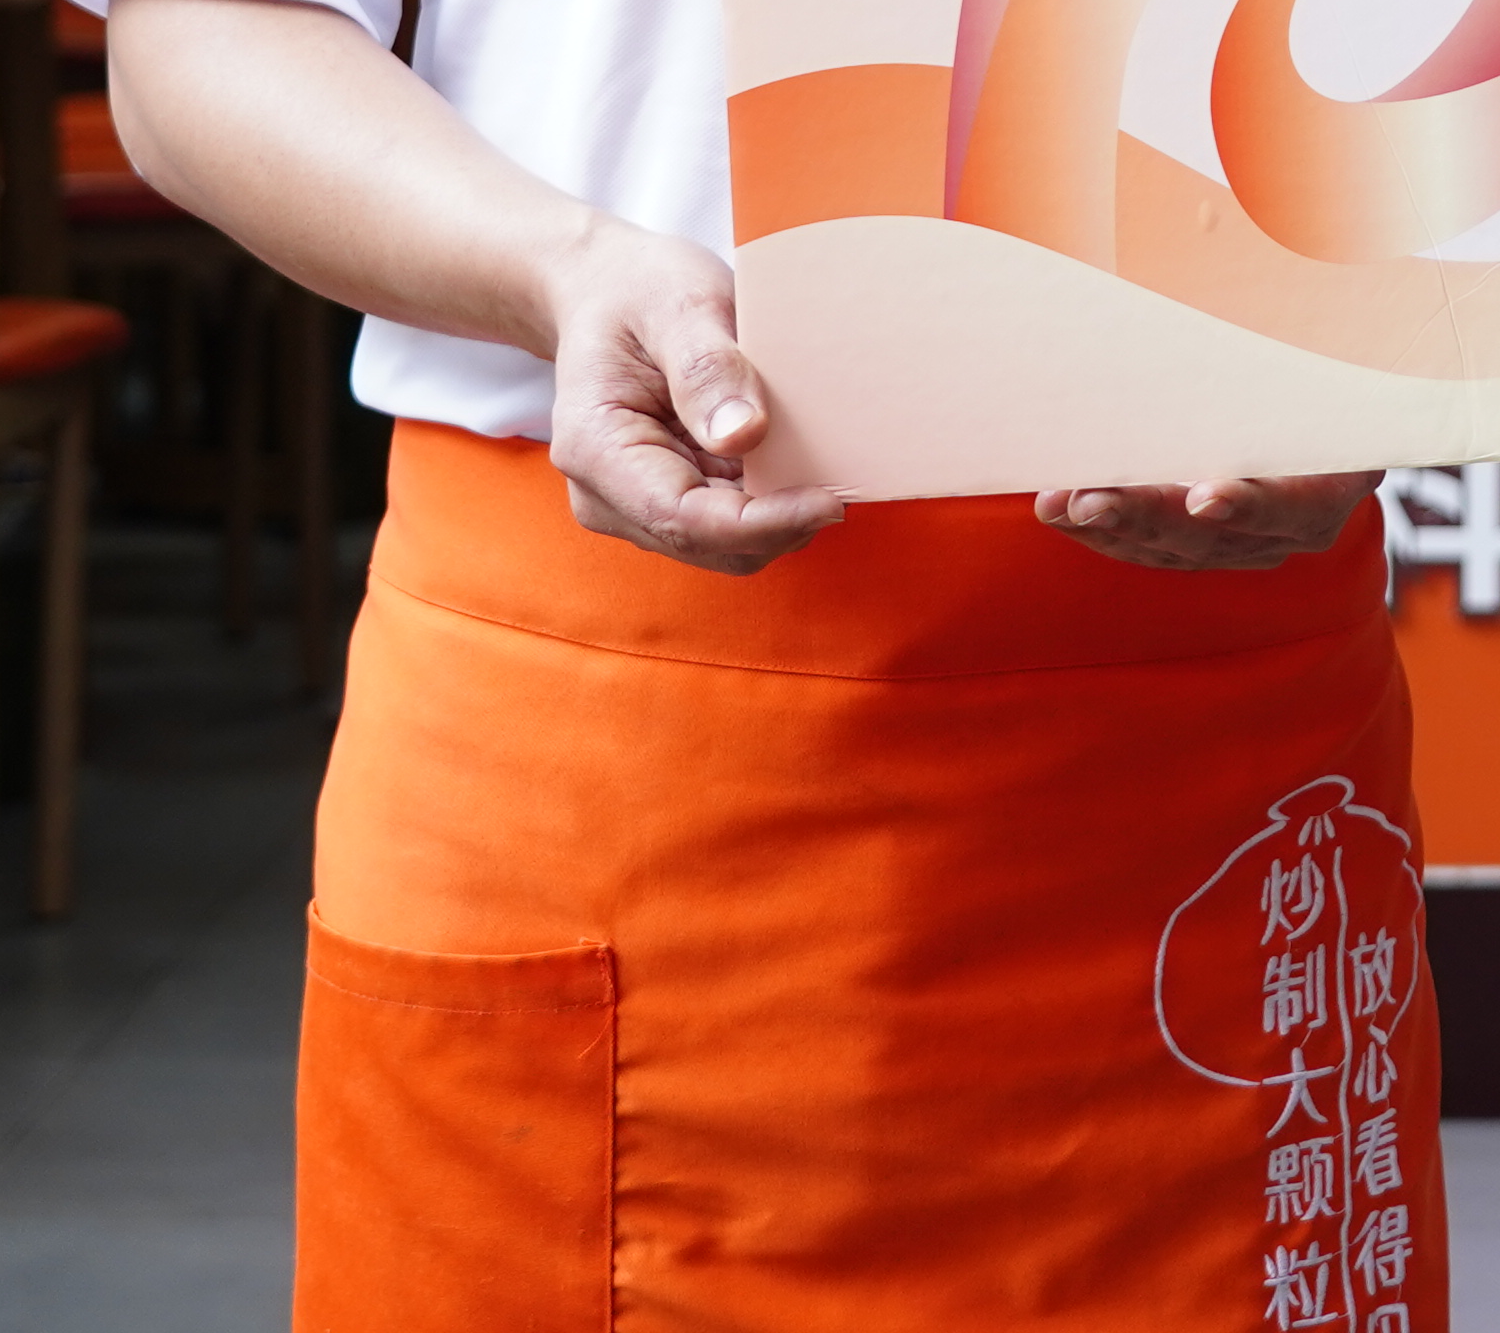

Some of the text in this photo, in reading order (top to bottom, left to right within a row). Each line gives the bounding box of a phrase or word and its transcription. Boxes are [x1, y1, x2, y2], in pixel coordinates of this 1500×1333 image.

[1258, 853, 1342, 1332] 炒制大颗粒
